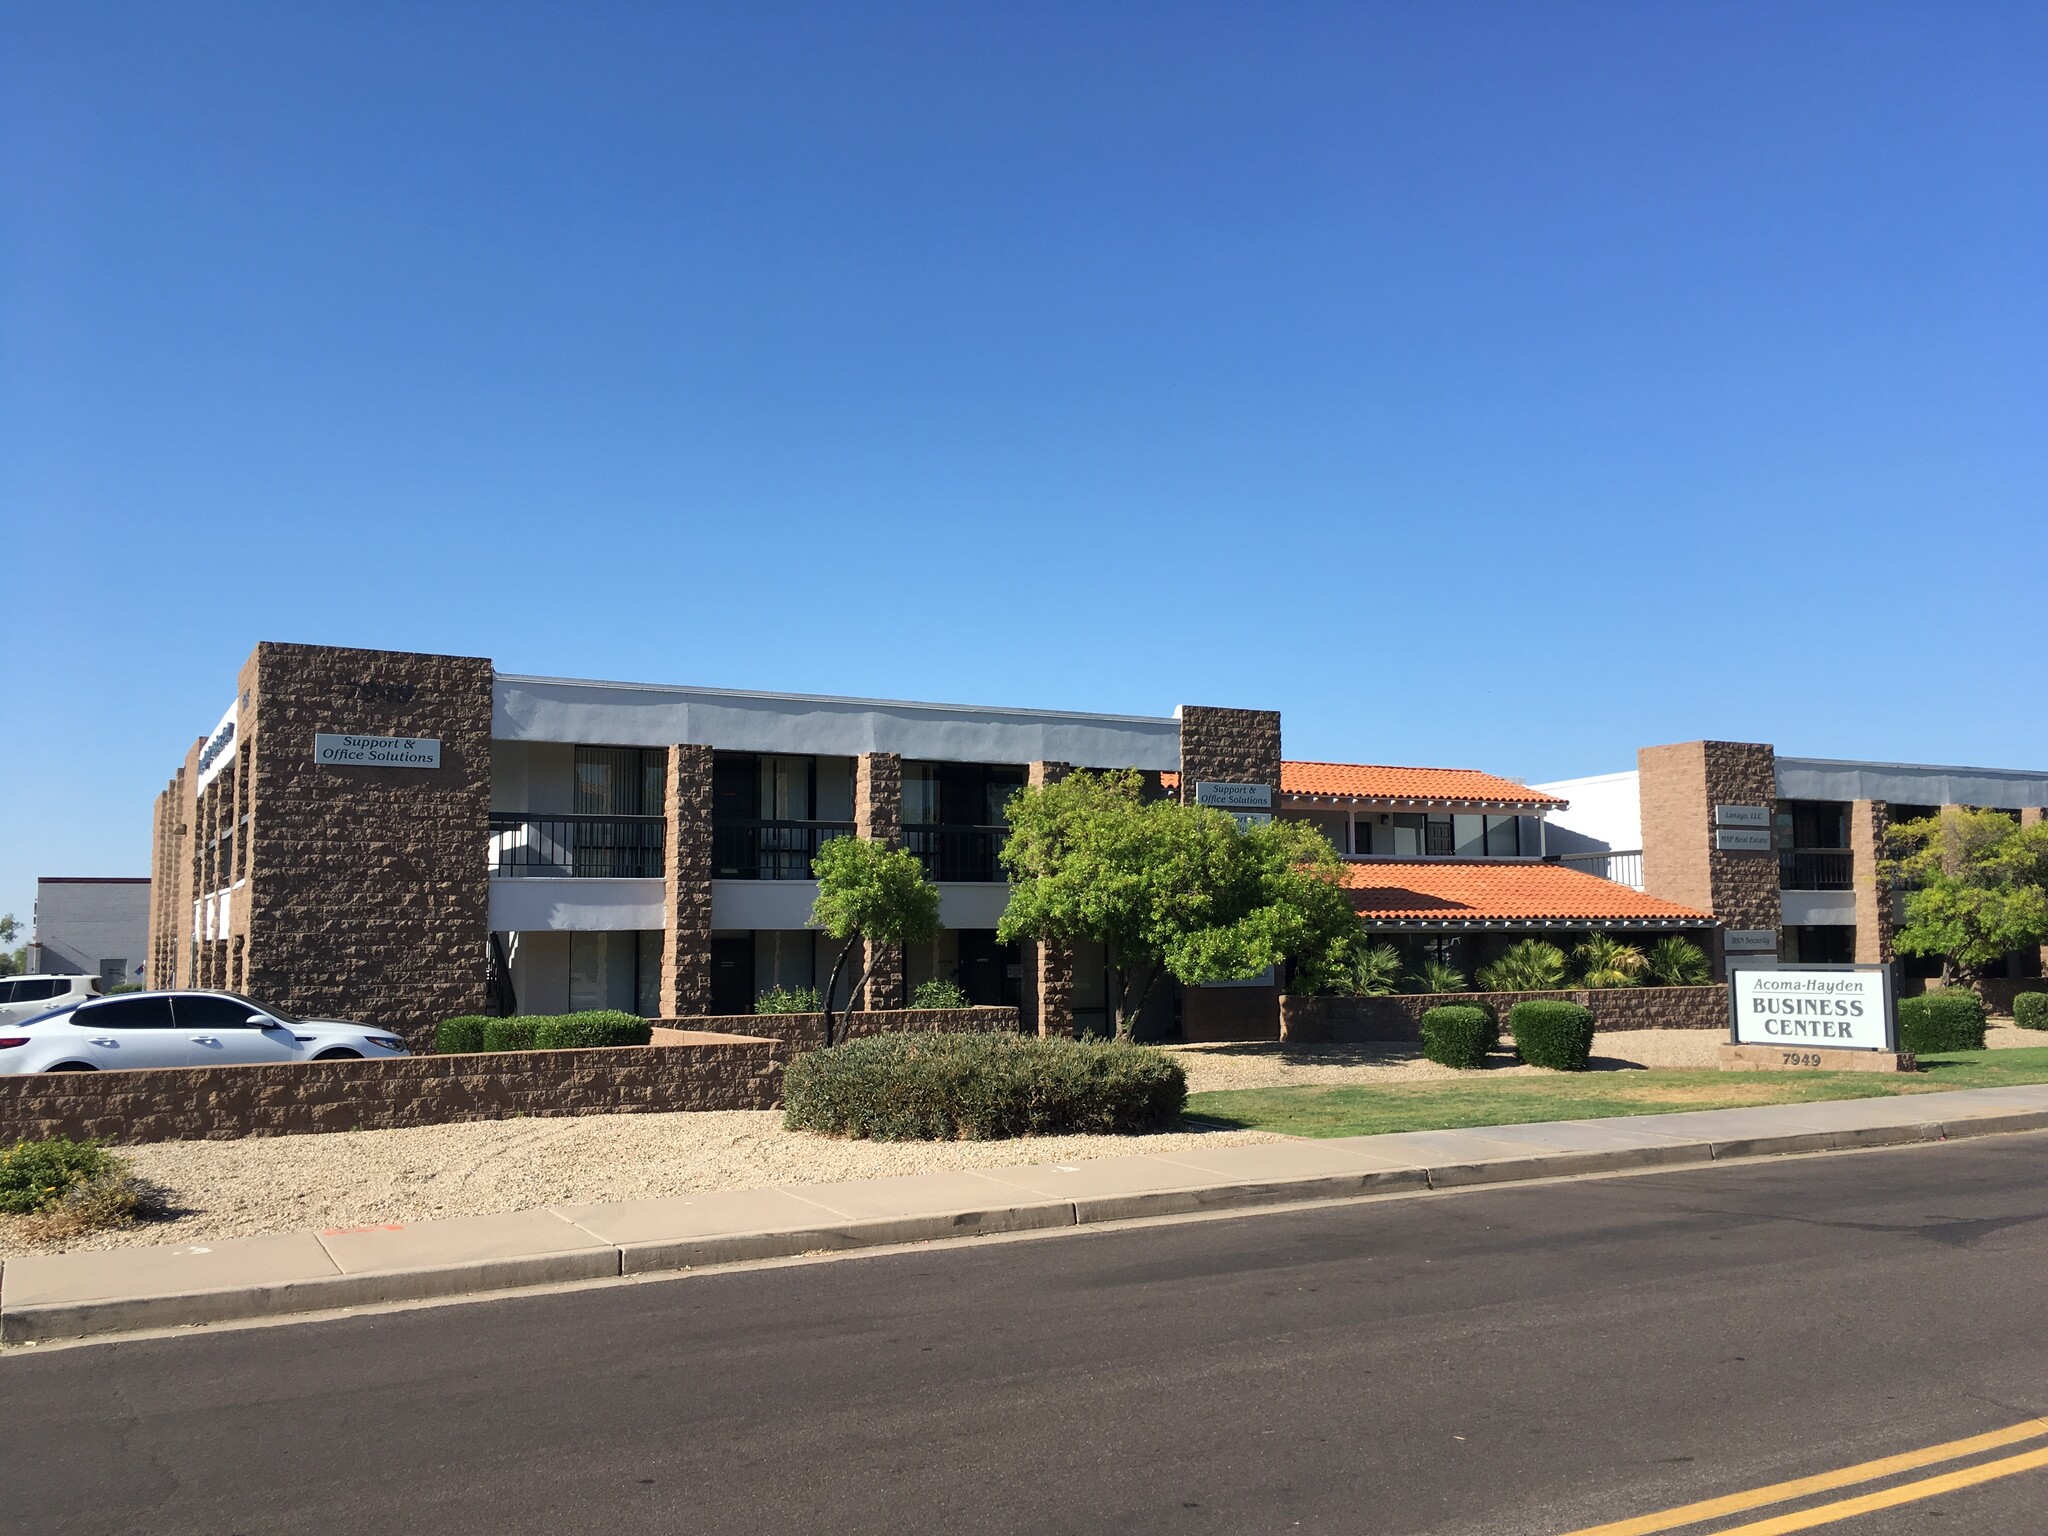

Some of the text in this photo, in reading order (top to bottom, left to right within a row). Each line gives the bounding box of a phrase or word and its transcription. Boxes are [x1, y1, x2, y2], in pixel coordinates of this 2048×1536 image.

[343, 736, 416, 750] Support &
[322, 748, 434, 763] Office Solutions
[1213, 784, 1257, 795] Support &
[1201, 794, 1268, 805] Office Solutions
[1751, 812, 1763, 820] LLC
[1749, 836, 1768, 844] Estate
[1745, 937, 1770, 946] Security
[1754, 979, 1864, 995] Acoma-Hayden
[1752, 997, 1864, 1018] BUSINESS
[1764, 1018, 1854, 1039] CENTER
[1782, 1053, 1822, 1067] 7949
